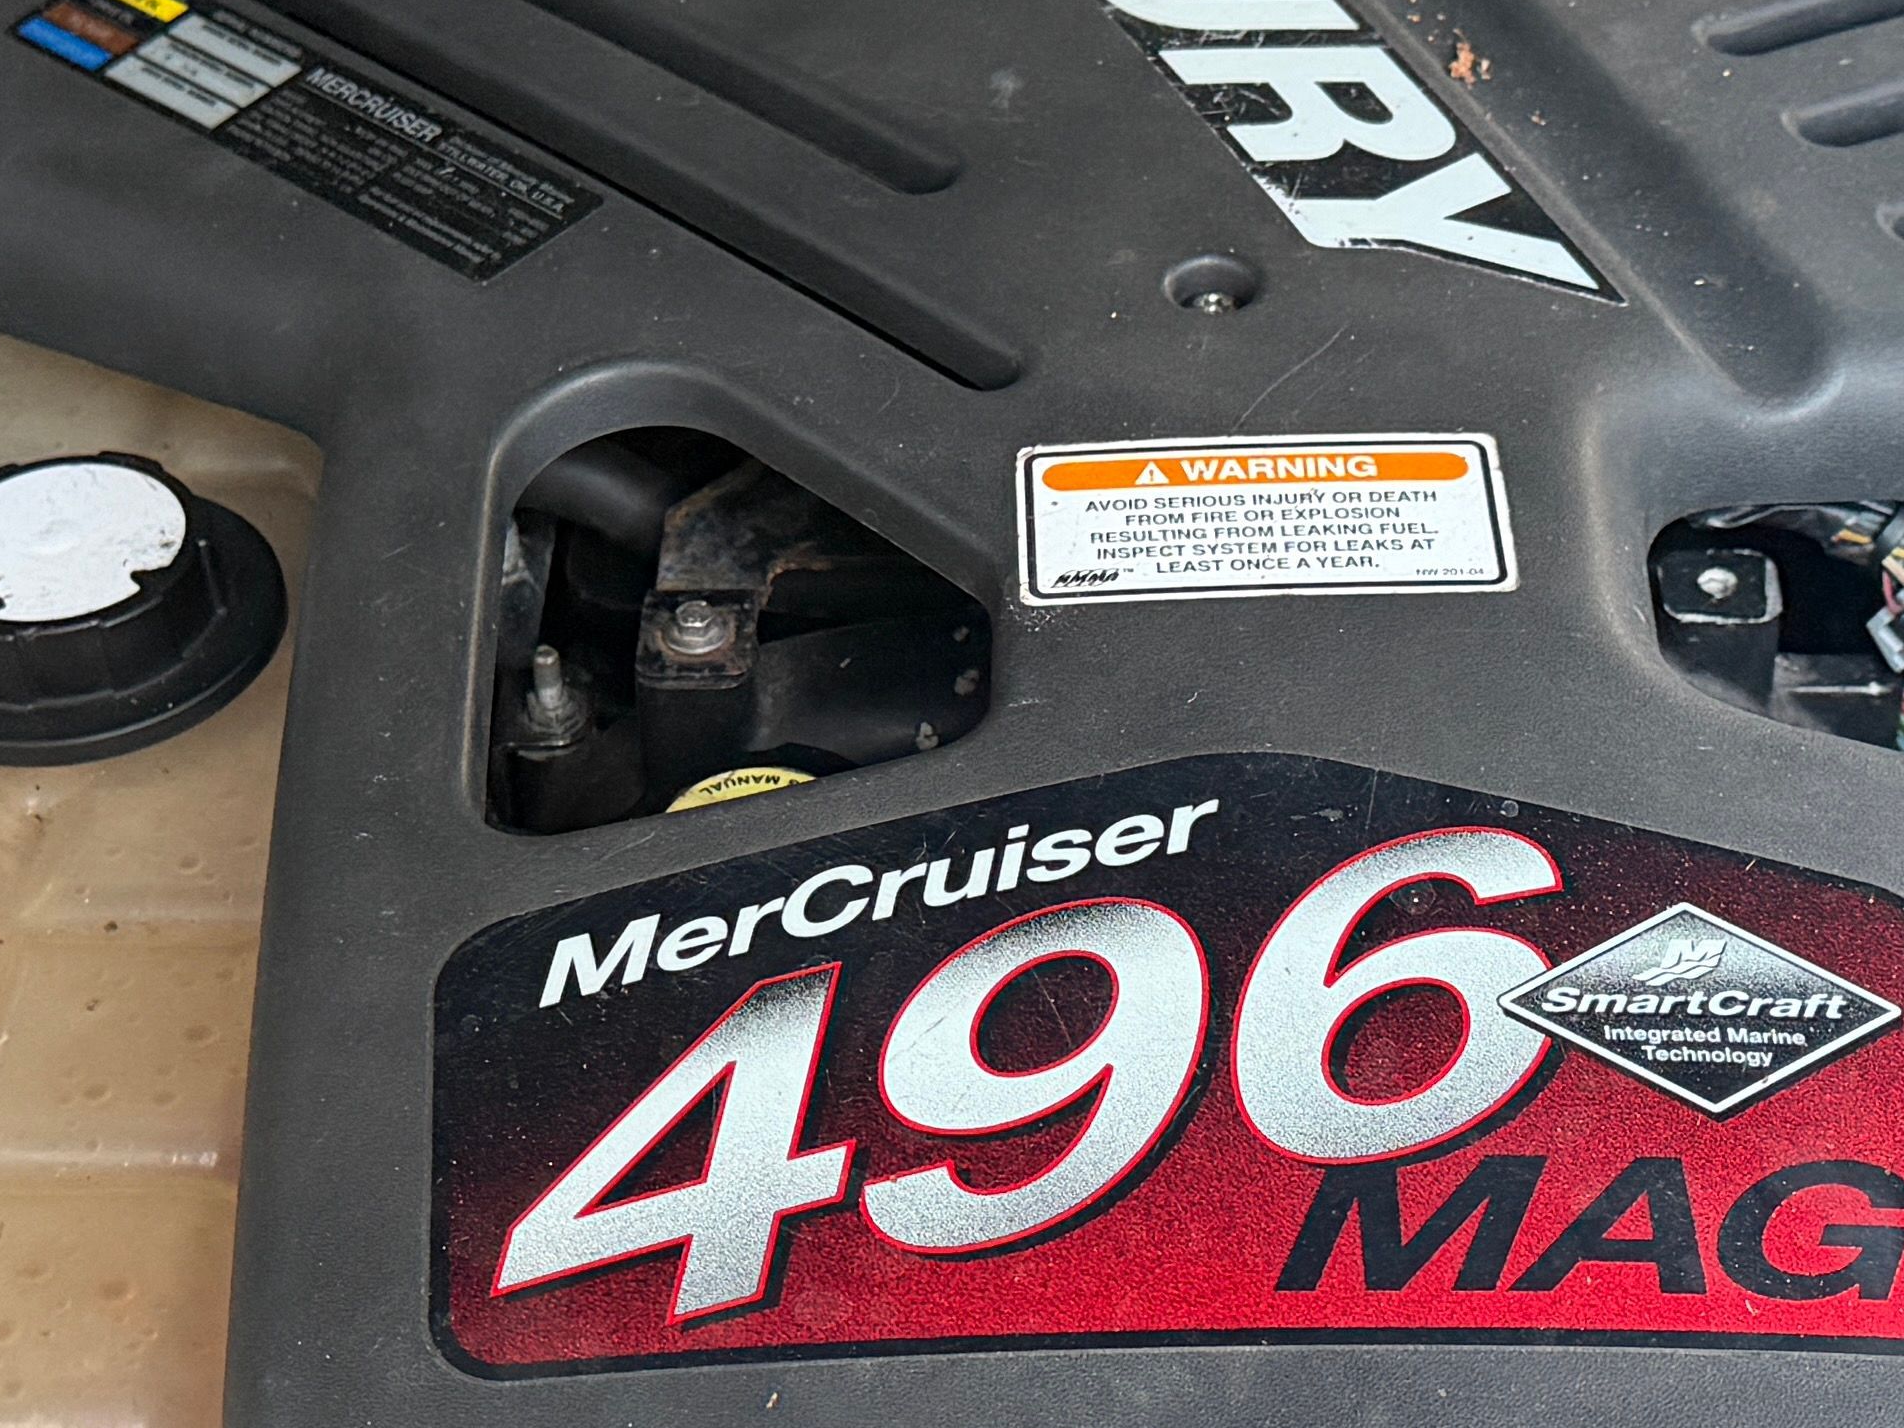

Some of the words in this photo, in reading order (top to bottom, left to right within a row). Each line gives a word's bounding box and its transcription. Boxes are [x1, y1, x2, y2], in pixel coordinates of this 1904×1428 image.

[305, 66, 443, 143] MERCRUISER
[1179, 454, 1378, 483] WARNING
[1086, 498, 1147, 513] AVOID
[1154, 493, 1245, 510] SERIOUS
[1253, 491, 1325, 506] INJURY
[1332, 491, 1362, 504] OR
[1369, 490, 1437, 503] DEATH
[1126, 513, 1184, 527] FROM
[1192, 511, 1237, 524] FIRE
[1244, 509, 1274, 522] OR
[1281, 506, 1400, 521] EXPLOSION
[1090, 528, 1207, 544] RESULTING
[1214, 525, 1274, 539] FROM
[1281, 523, 1373, 538] LEAKING
[1380, 522, 1439, 535] FUEL.
[1097, 545, 1186, 560] INSPECT
[1193, 542, 1278, 556] SYSTEM
[1284, 540, 1327, 553] FOR
[1334, 538, 1404, 552] LEAKS
[1411, 538, 1435, 550] AT
[1156, 559, 1224, 574] LEAST
[1230, 556, 1291, 571] ONCE
[1297, 557, 1311, 569] A
[1316, 556, 1380, 569] YEAR.
[698, 773, 780, 795] MANUAL
[538, 798, 1220, 1008] MerCruiser
[1541, 986, 1848, 1020] SmartCraft
[1603, 1024, 1721, 1045] Integrated
[1728, 1026, 1807, 1046] Marine
[1641, 1044, 1774, 1067] Technology
[490, 825, 1564, 1326] 496
